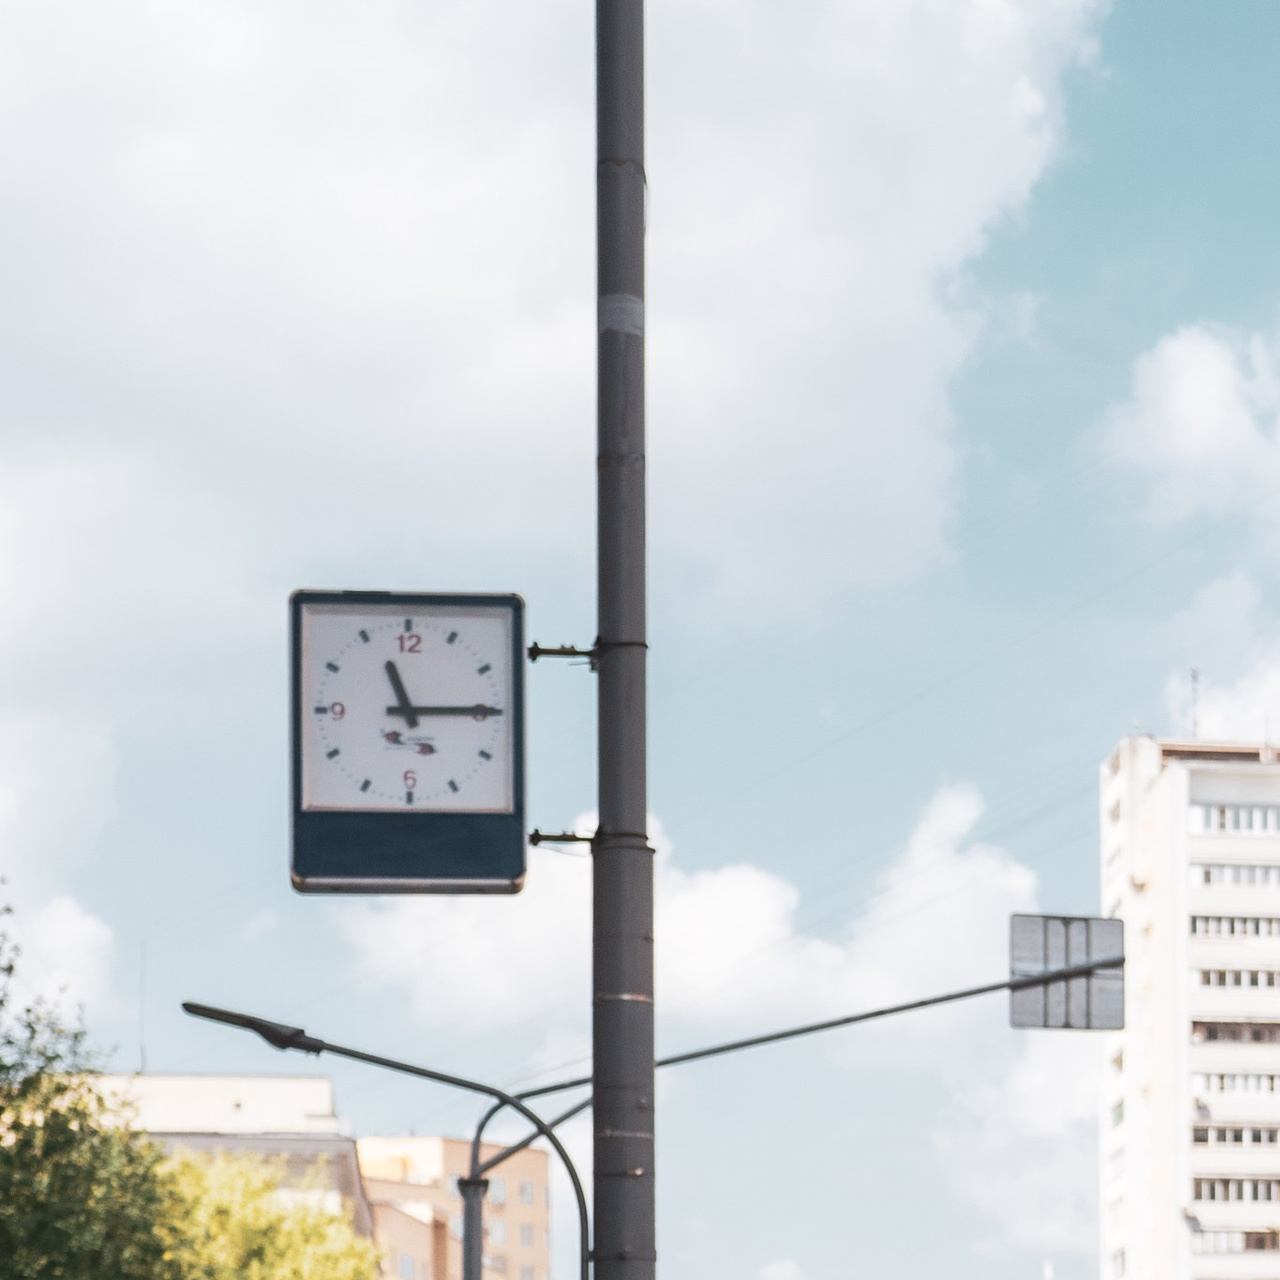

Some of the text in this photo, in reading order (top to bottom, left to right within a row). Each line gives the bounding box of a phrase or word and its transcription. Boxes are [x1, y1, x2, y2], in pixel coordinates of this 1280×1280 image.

[396, 634, 422, 654] 12
[330, 701, 346, 721] 9
[403, 769, 417, 789] 6
